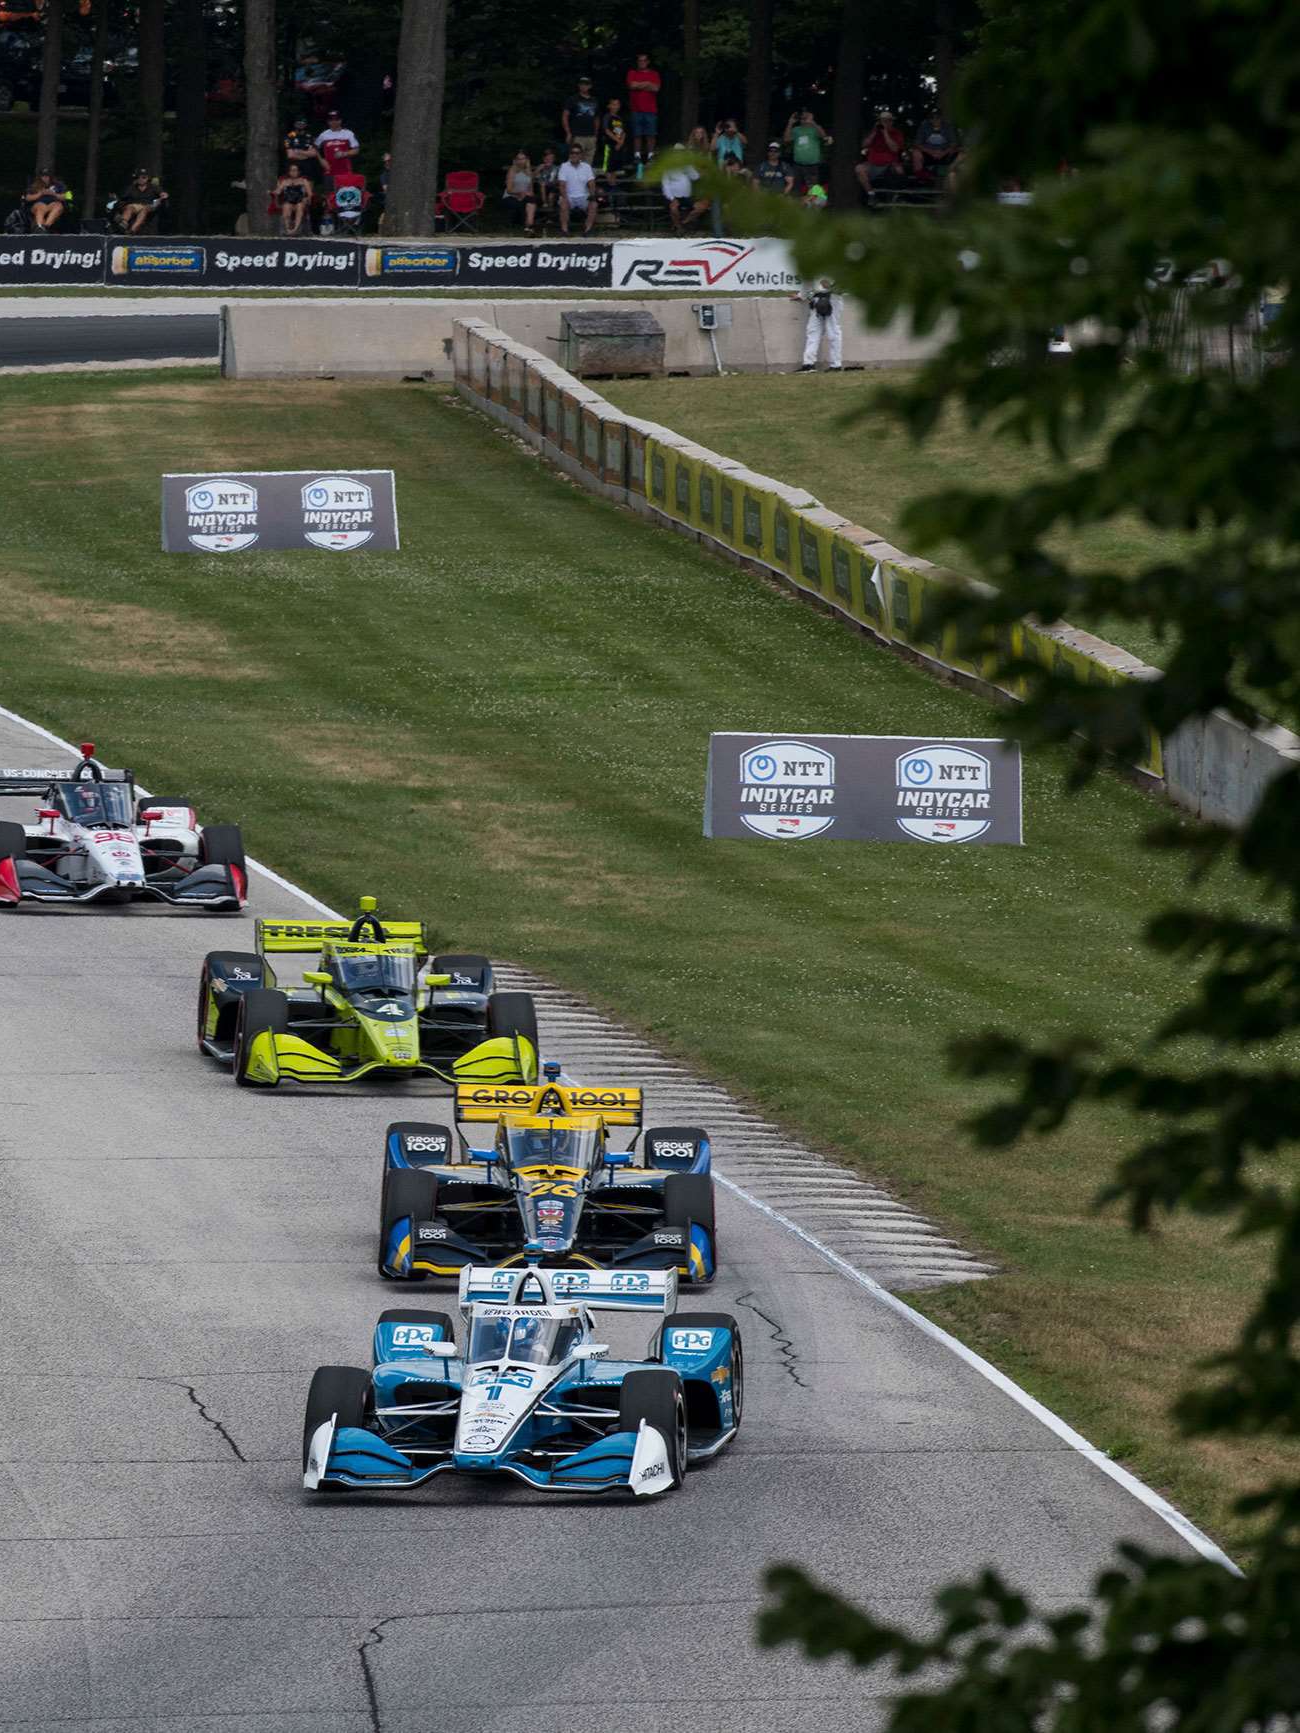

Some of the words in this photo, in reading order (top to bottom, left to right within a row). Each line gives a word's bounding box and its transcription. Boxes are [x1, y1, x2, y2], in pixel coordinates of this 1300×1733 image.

[31, 248, 101, 267] Drying!
[134, 254, 195, 267] absorber
[215, 251, 278, 271] Speed
[284, 252, 355, 270] Drying!
[388, 255, 448, 267] absorber
[468, 251, 530, 270] Speed
[537, 252, 608, 271] Drying!
[736, 270, 802, 285] Vehicles
[218, 493, 250, 506] NTT
[333, 491, 365, 503] NTT
[188, 511, 258, 528] INDYCAR
[304, 511, 372, 524] INDYCAR
[201, 525, 242, 534] SERIES
[317, 522, 359, 531] SERIES
[782, 761, 826, 777] NTT
[938, 765, 981, 781] NTT
[740, 787, 834, 805] INDYCAR
[897, 791, 991, 809] INDYCAR
[759, 803, 813, 814] SERIES
[915, 807, 970, 818] SERIES
[376, 1003, 405, 1016] 4
[407, 1136, 446, 1144] GROUP
[407, 1143, 446, 1152] 1001
[654, 1148, 693, 1158] 1001
[524, 1181, 578, 1199] 26
[553, 1274, 589, 1291] PPG
[612, 1276, 649, 1292] PPG
[484, 1309, 552, 1318] NEWGARDEN
[395, 1328, 431, 1344] PPG
[674, 1332, 711, 1348] PPG
[639, 1462, 665, 1481] HITACHI
